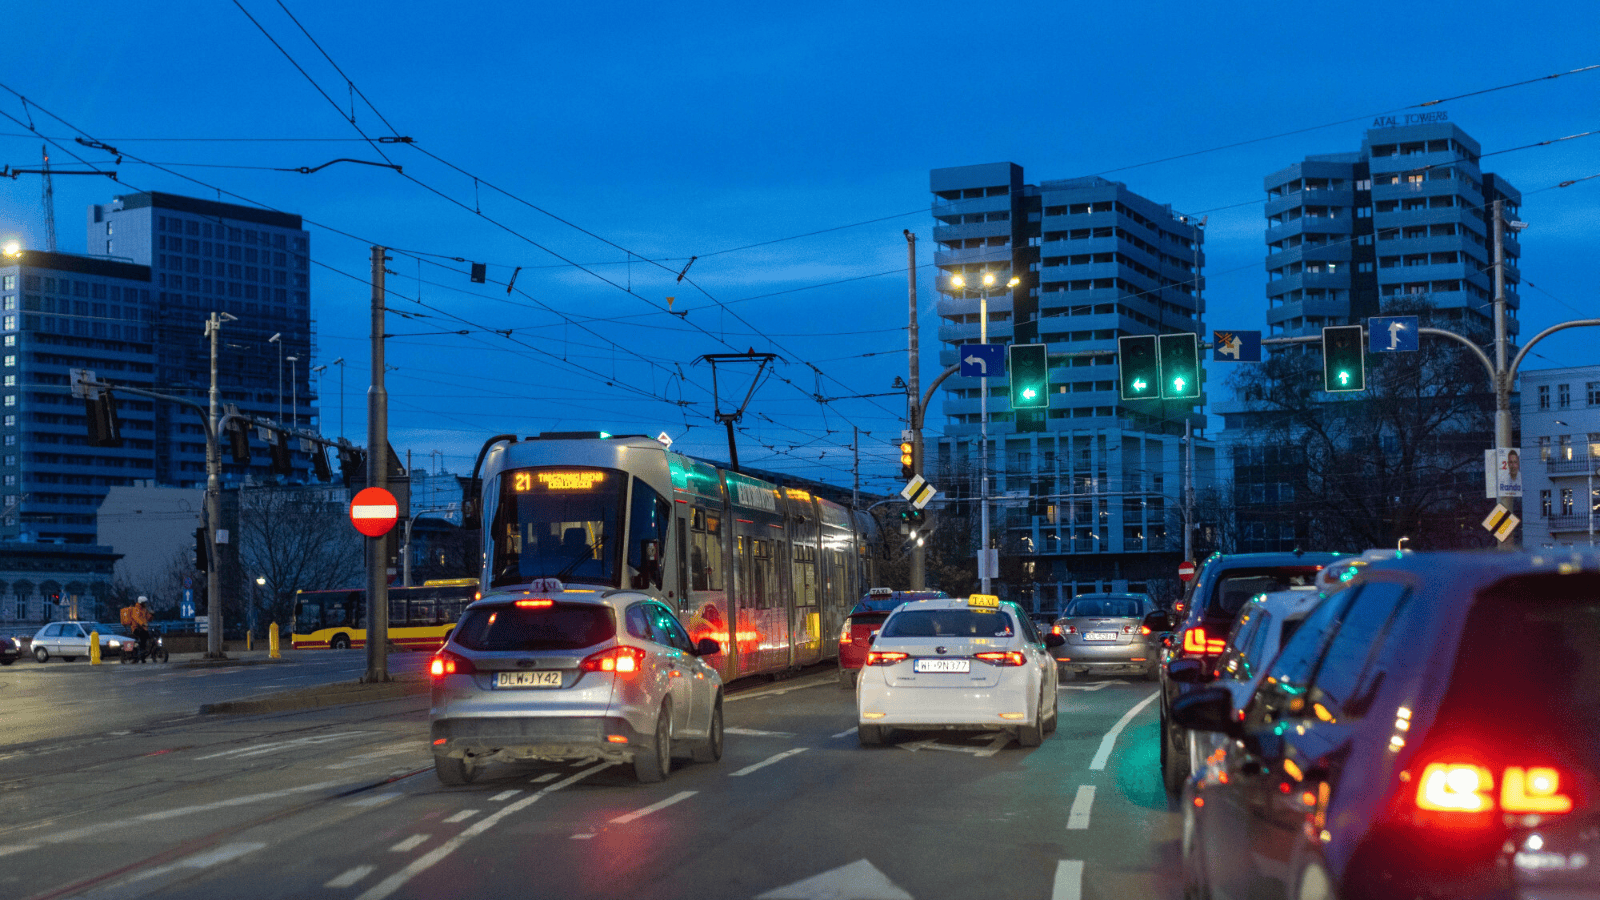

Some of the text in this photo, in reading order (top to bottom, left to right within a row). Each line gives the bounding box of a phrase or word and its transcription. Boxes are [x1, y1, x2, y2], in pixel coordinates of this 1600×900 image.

[1373, 111, 1448, 127] ATAL TOWERS
[1502, 461, 1507, 470] 2
[515, 473, 531, 490] 21
[534, 581, 557, 589] TAXI
[972, 596, 995, 606] TAXI
